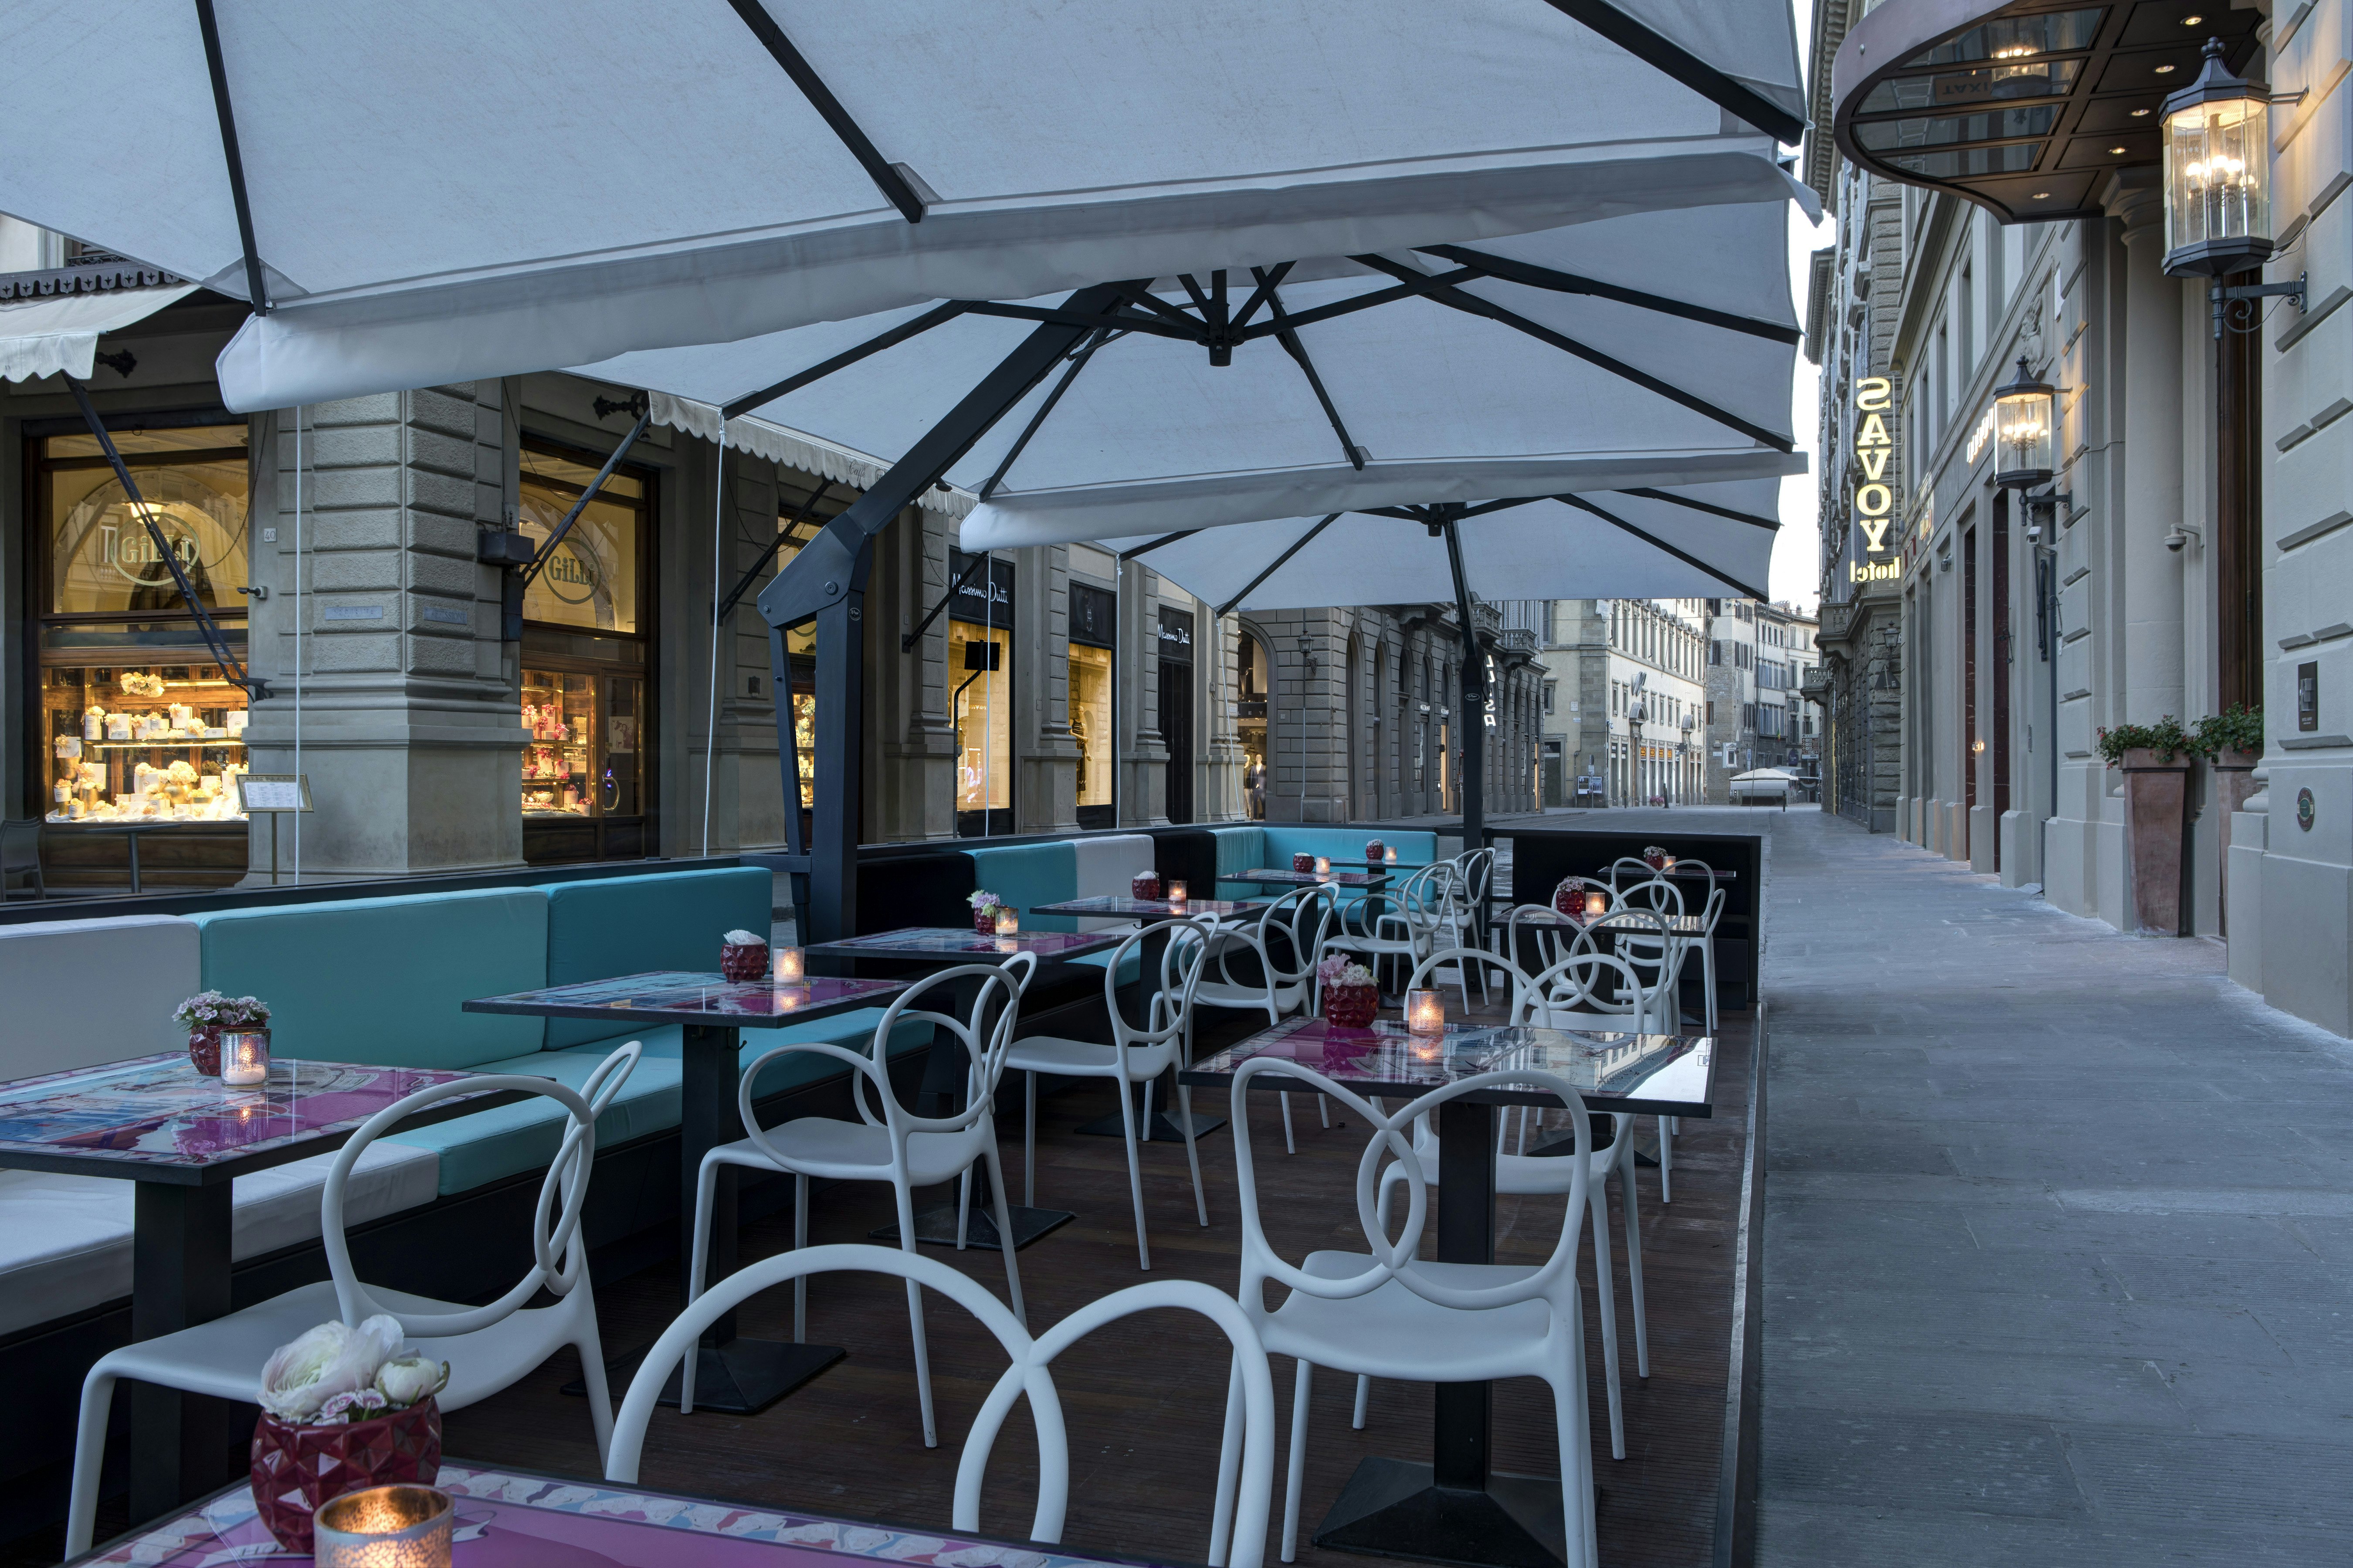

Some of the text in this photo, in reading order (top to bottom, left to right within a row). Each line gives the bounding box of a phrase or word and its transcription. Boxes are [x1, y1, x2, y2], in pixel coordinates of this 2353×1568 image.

[265, 531, 275, 540] 40
[952, 573, 1008, 604] Massimo Dutti
[1158, 623, 1190, 644] Massimo Dutti
